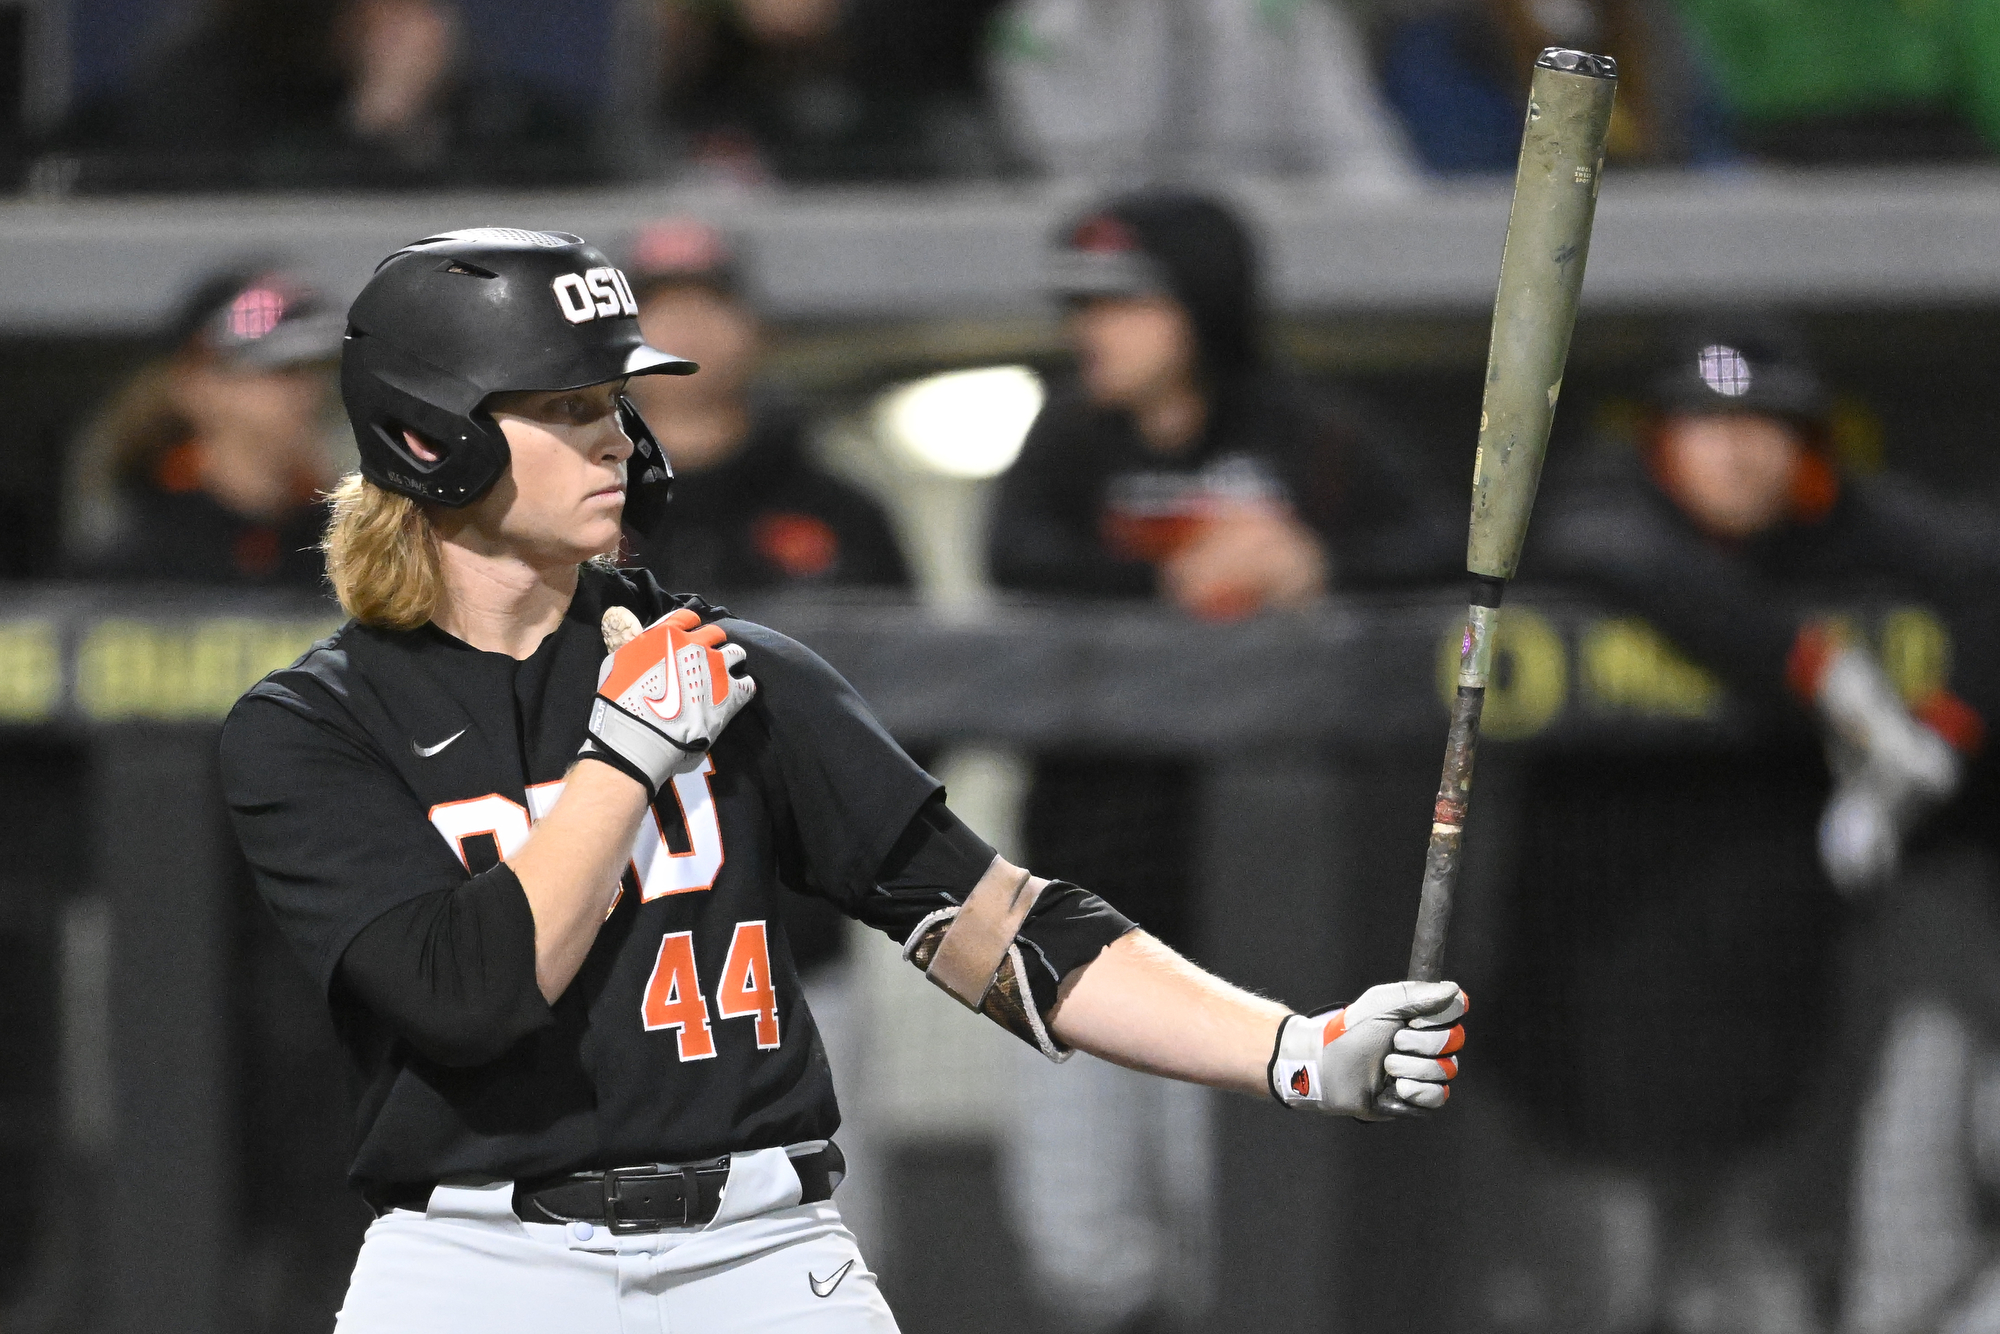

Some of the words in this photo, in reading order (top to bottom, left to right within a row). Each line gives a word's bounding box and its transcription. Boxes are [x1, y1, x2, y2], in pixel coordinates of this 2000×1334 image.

[552, 266, 639, 325] OSU
[593, 701, 606, 733] TROUT
[641, 920, 780, 1062] 44
